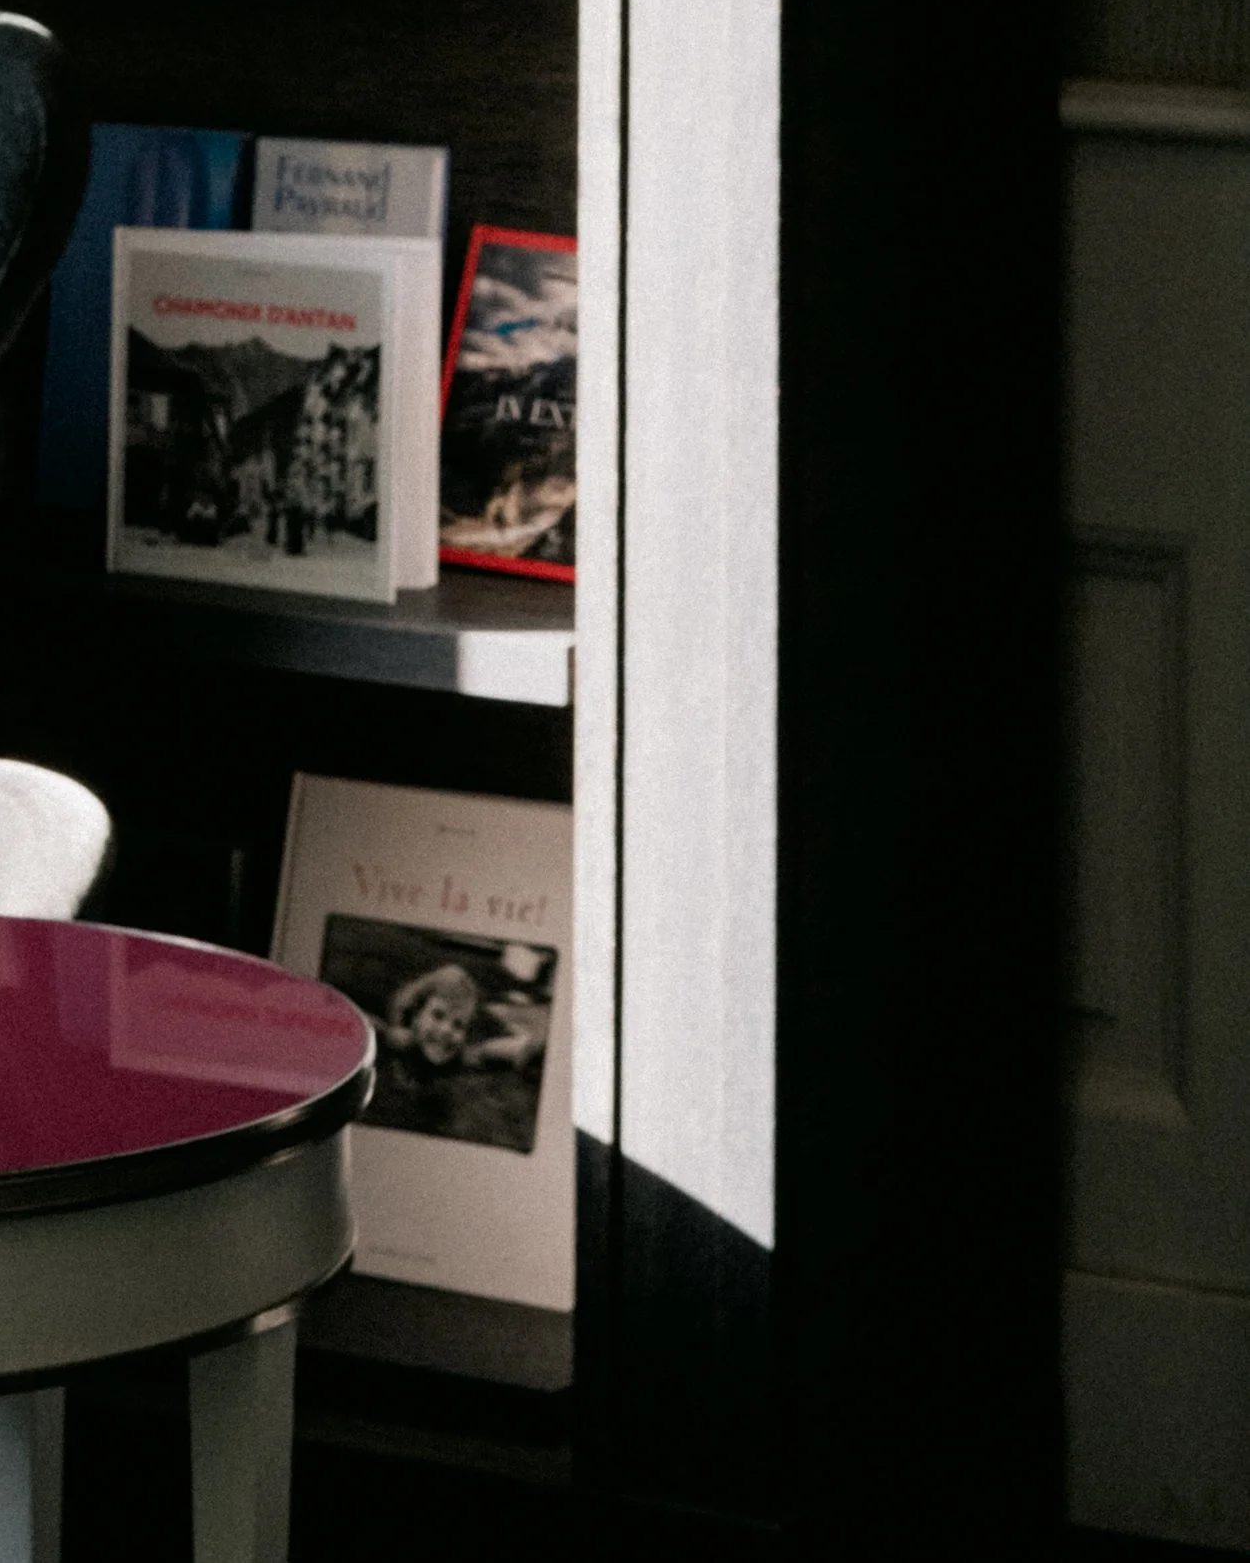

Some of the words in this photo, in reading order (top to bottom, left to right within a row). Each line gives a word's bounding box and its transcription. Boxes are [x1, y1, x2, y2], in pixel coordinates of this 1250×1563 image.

[153, 294, 261, 322] CHAMONIX
[352, 862, 425, 906] Vive
[440, 875, 470, 914] la
